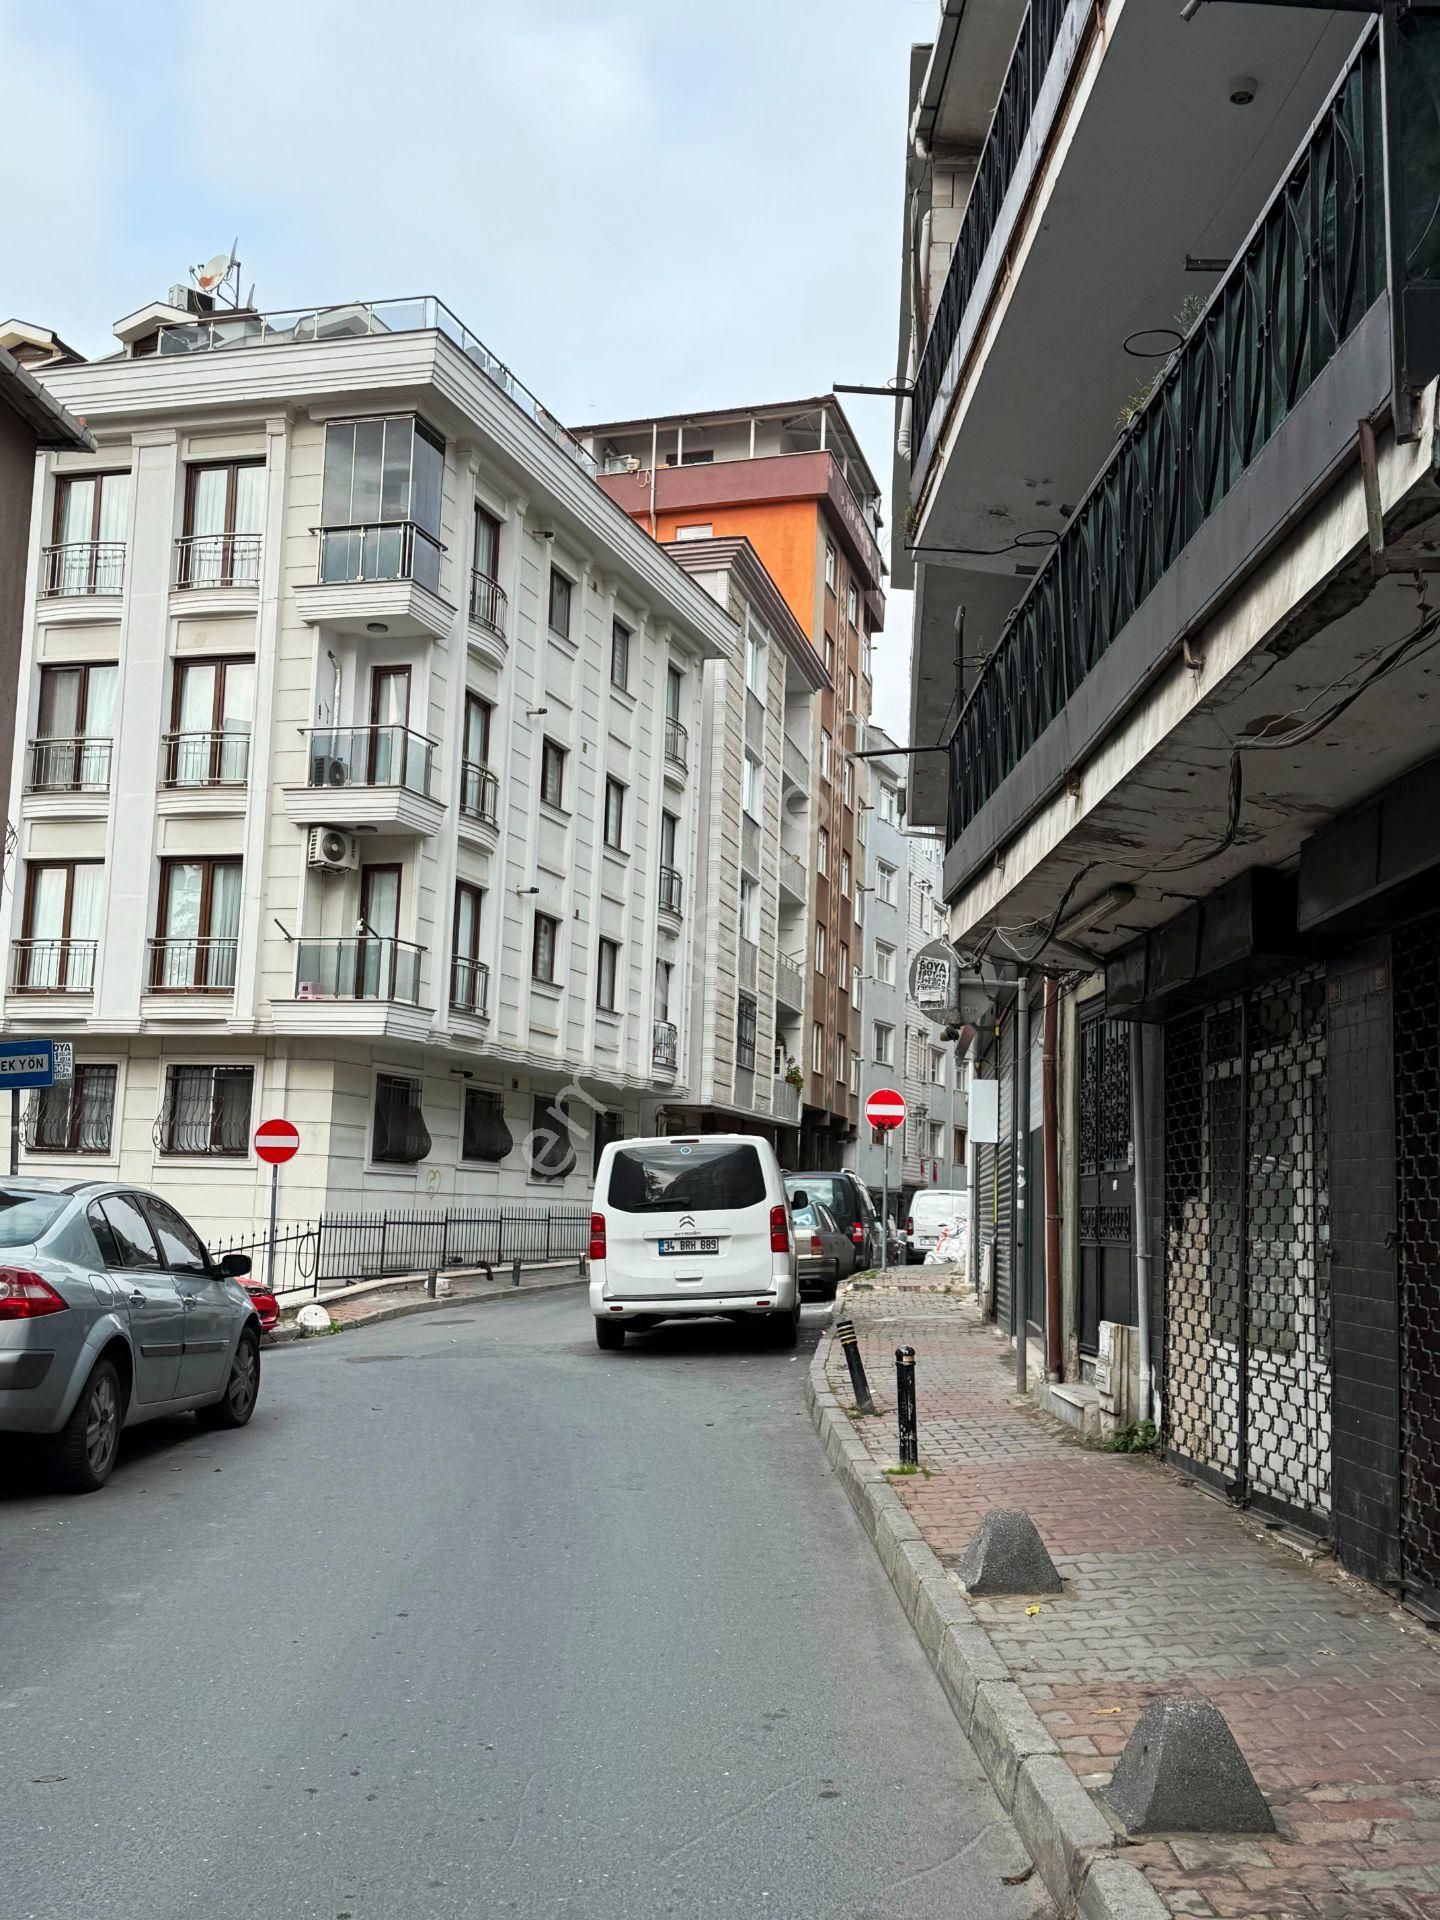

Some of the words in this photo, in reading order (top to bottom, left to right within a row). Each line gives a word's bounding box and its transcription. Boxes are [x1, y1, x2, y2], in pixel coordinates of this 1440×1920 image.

[53, 1044, 71, 1052] OYA
[1, 1060, 16, 1071] EK
[19, 1056, 43, 1070] YÖN
[664, 1241, 675, 1251] 34
[680, 1240, 696, 1251] BRH
